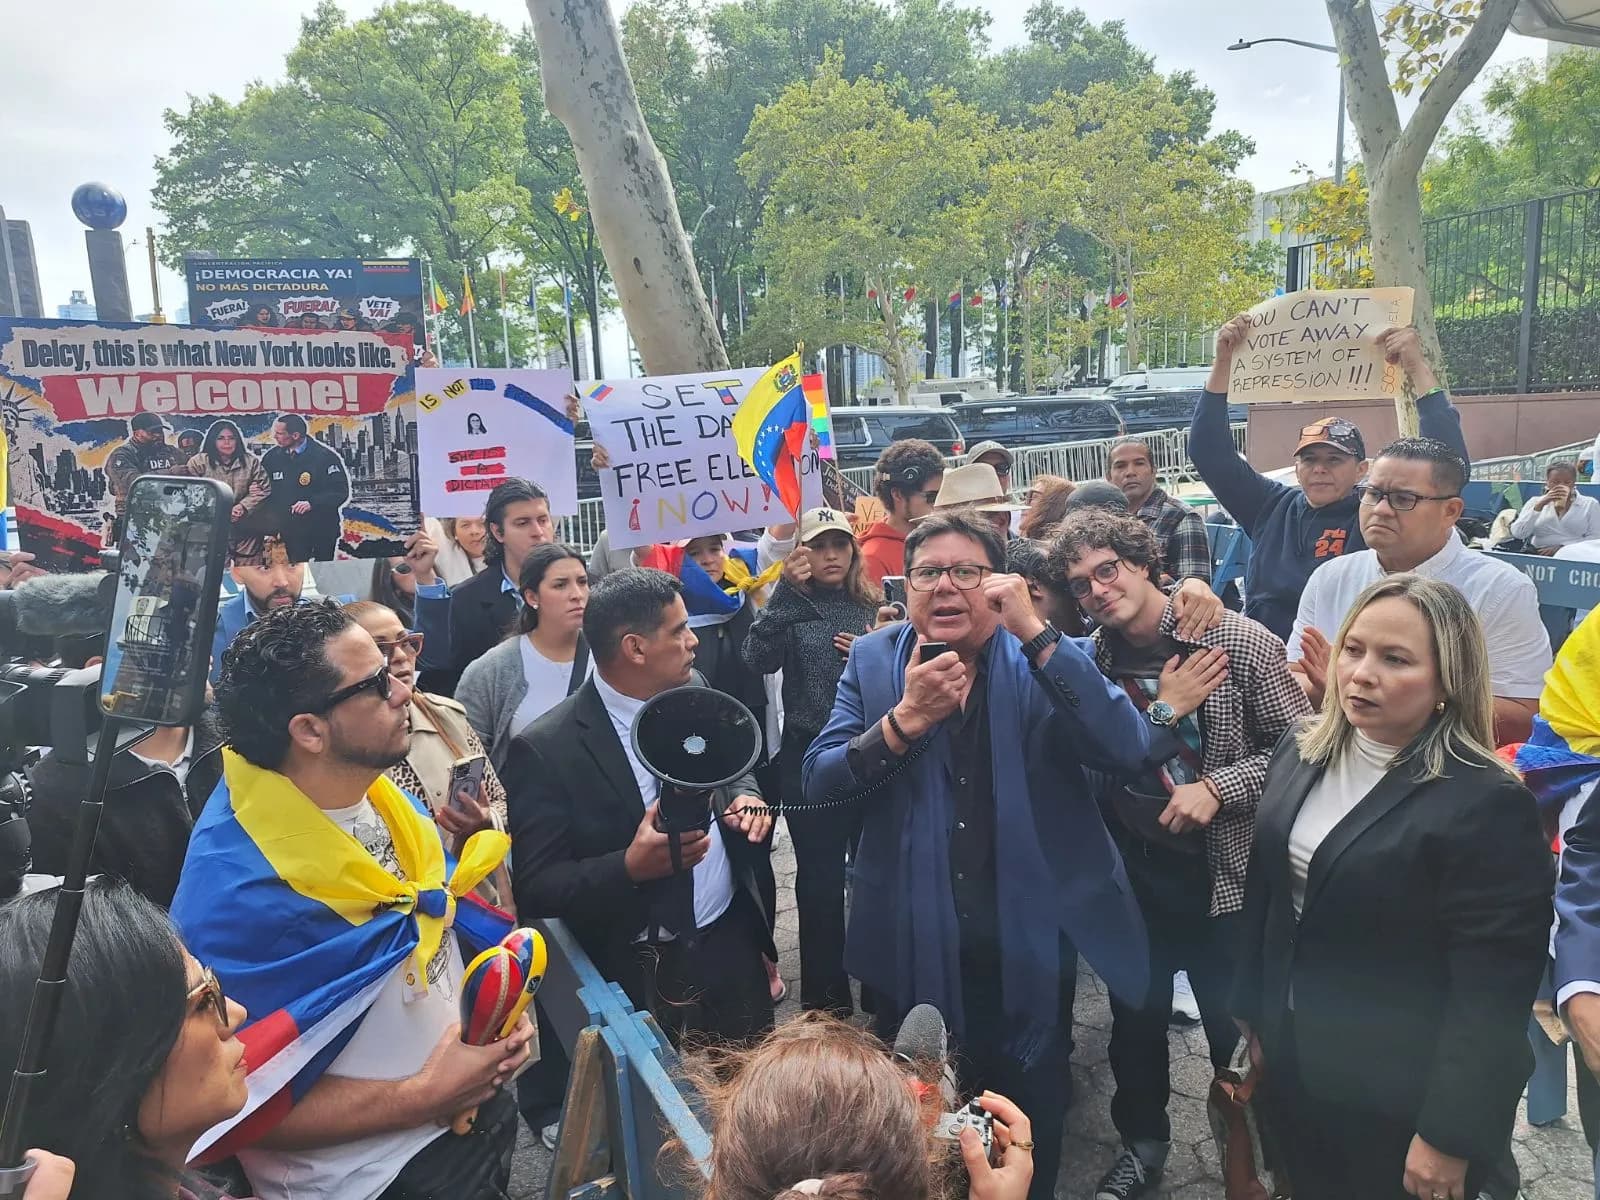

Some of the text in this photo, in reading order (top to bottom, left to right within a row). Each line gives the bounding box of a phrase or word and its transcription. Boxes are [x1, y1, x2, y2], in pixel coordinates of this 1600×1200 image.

[195, 268, 353, 281] ¡DEMOCRACIA YA!
[196, 283, 216, 292] NO
[252, 283, 329, 291] DICTADURA
[211, 301, 246, 318] FUERA!
[283, 300, 337, 315] FUERA!
[366, 300, 393, 309] VETE
[369, 309, 391, 318] YA!
[1290, 297, 1370, 321] CAN'T
[1247, 323, 1369, 351] VOTE AWAY
[22, 339, 91, 372] Delcy,
[93, 339, 136, 367] this
[138, 339, 159, 367] is
[160, 340, 213, 367] what
[214, 340, 257, 367] New
[259, 341, 305, 367] York
[306, 341, 356, 368] looks
[358, 342, 396, 369] like.
[1233, 348, 1361, 374] A SYSTEM OF
[76, 374, 360, 417] Welcome!
[419, 379, 466, 410] IS NOT
[641, 379, 743, 409] SET
[610, 413, 737, 452] THE DA
[449, 450, 475, 463] SHE
[612, 458, 697, 497] FREE
[1315, 539, 1345, 558] 24
[1525, 564, 1557, 583] NOT
